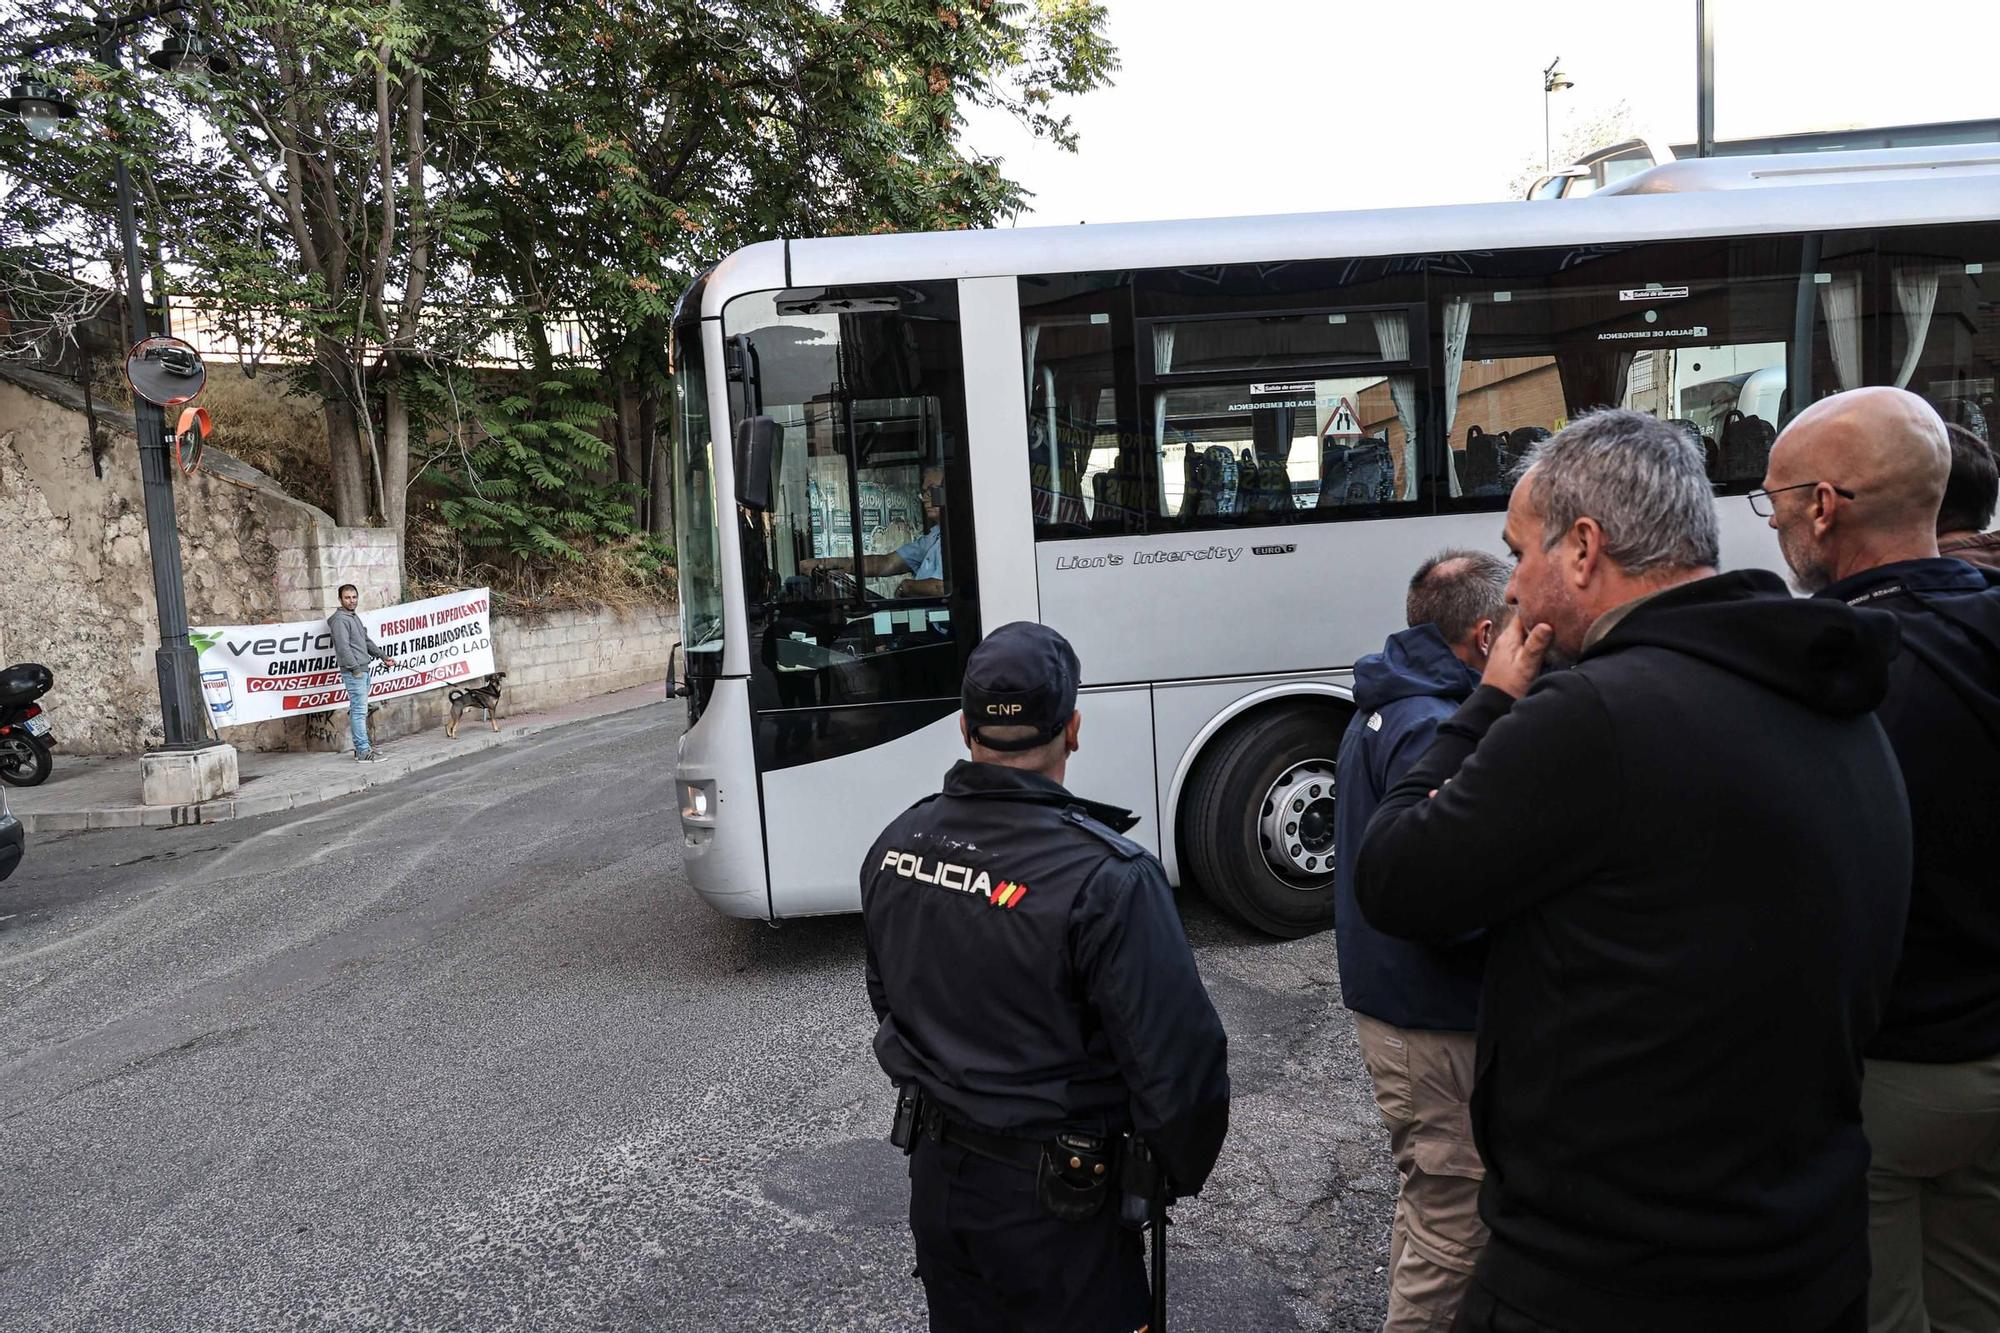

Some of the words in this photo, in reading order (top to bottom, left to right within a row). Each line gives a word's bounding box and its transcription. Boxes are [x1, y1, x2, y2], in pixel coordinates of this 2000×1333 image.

[1056, 553, 1124, 571] Lion's
[1133, 545, 1244, 563] Intercity
[1255, 546, 1281, 555] EURO
[1286, 544, 1294, 553] 6
[381, 614, 428, 638] PRESIONA
[429, 613, 436, 627] Y
[400, 642, 407, 654] A
[409, 621, 482, 653] TRABAJADORES
[463, 638, 493, 654] LAD
[297, 692, 330, 707] POR
[425, 663, 464, 683] DIGNA
[986, 704, 1022, 715] CNP
[880, 850, 992, 897] POLICIA
